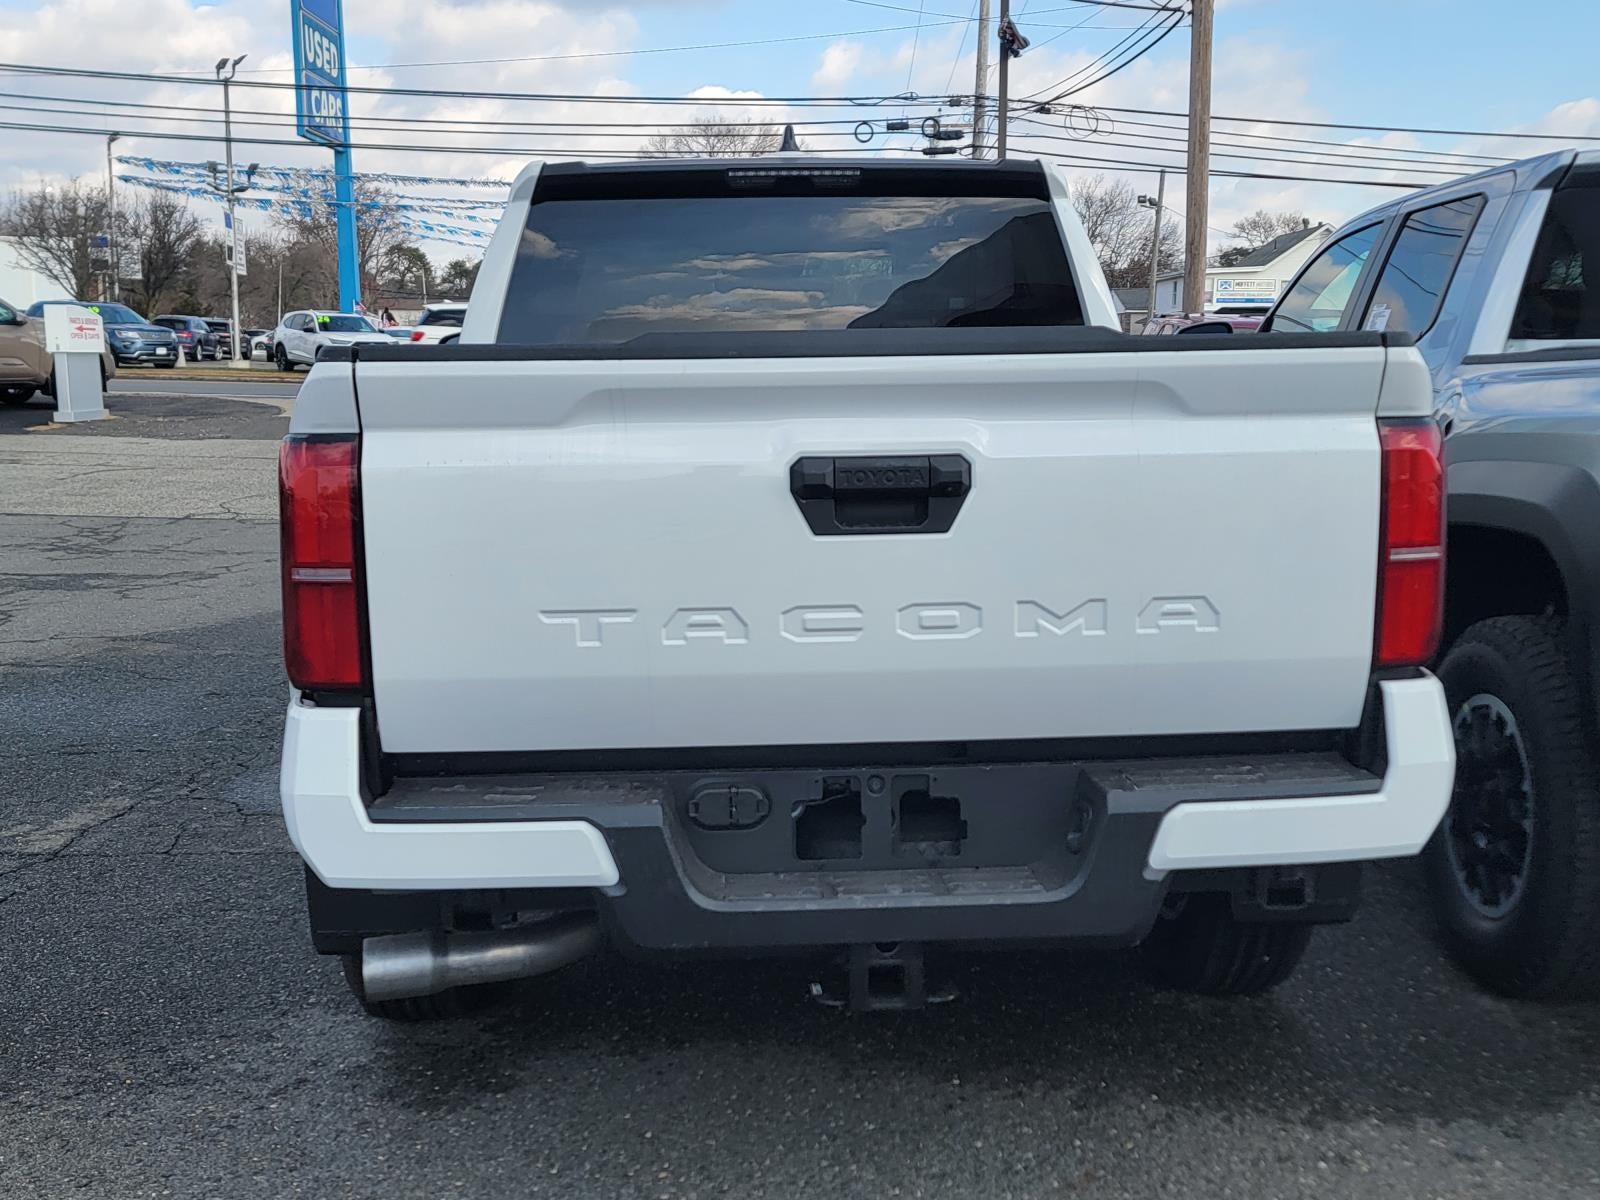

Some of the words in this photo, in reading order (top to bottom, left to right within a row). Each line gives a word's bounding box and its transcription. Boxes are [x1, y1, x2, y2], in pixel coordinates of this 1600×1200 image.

[304, 23, 339, 78] USED
[311, 88, 343, 133] CARS
[839, 469, 926, 486] TOYOTA
[537, 596, 1221, 647] TACOMA
